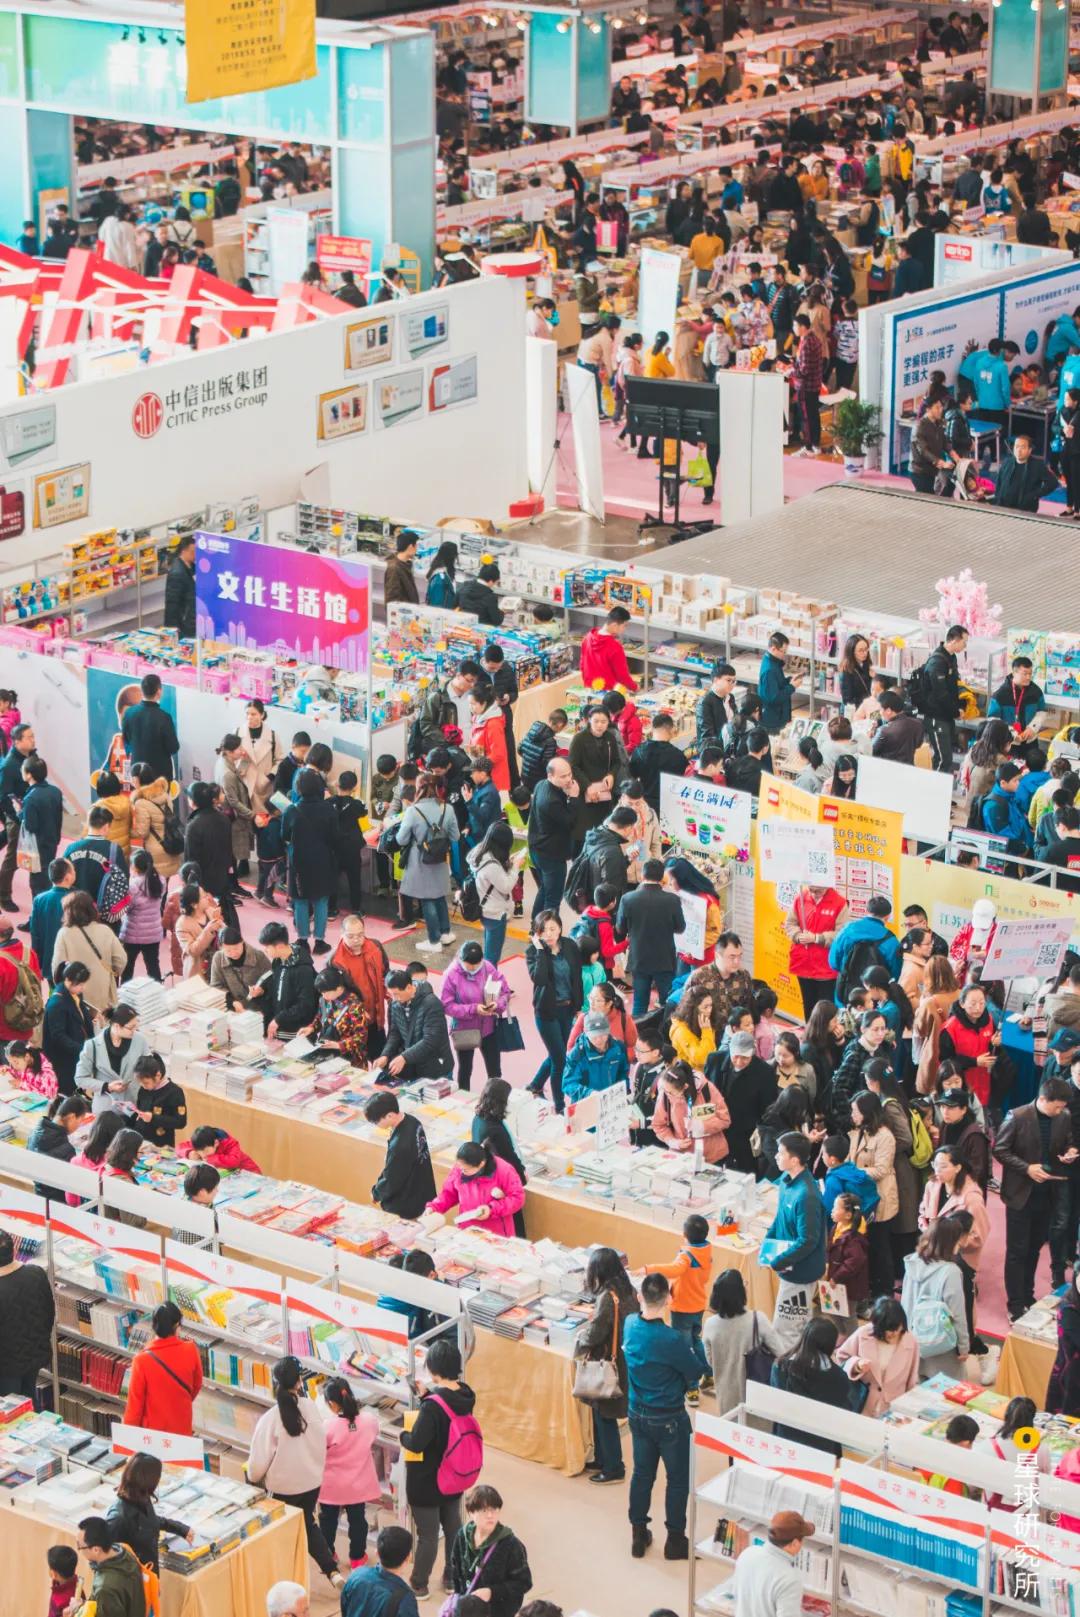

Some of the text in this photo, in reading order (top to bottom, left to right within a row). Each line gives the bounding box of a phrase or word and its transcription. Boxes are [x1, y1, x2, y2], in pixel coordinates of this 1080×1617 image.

[903, 344, 955, 371] 学编程的孩子
[166, 366, 268, 411] 中信出版集团
[903, 369, 929, 388] 更强大
[166, 392, 268, 429] CITIC Press Group
[217, 571, 348, 624] 文化生活馆
[778, 1304, 808, 1316] adidas
